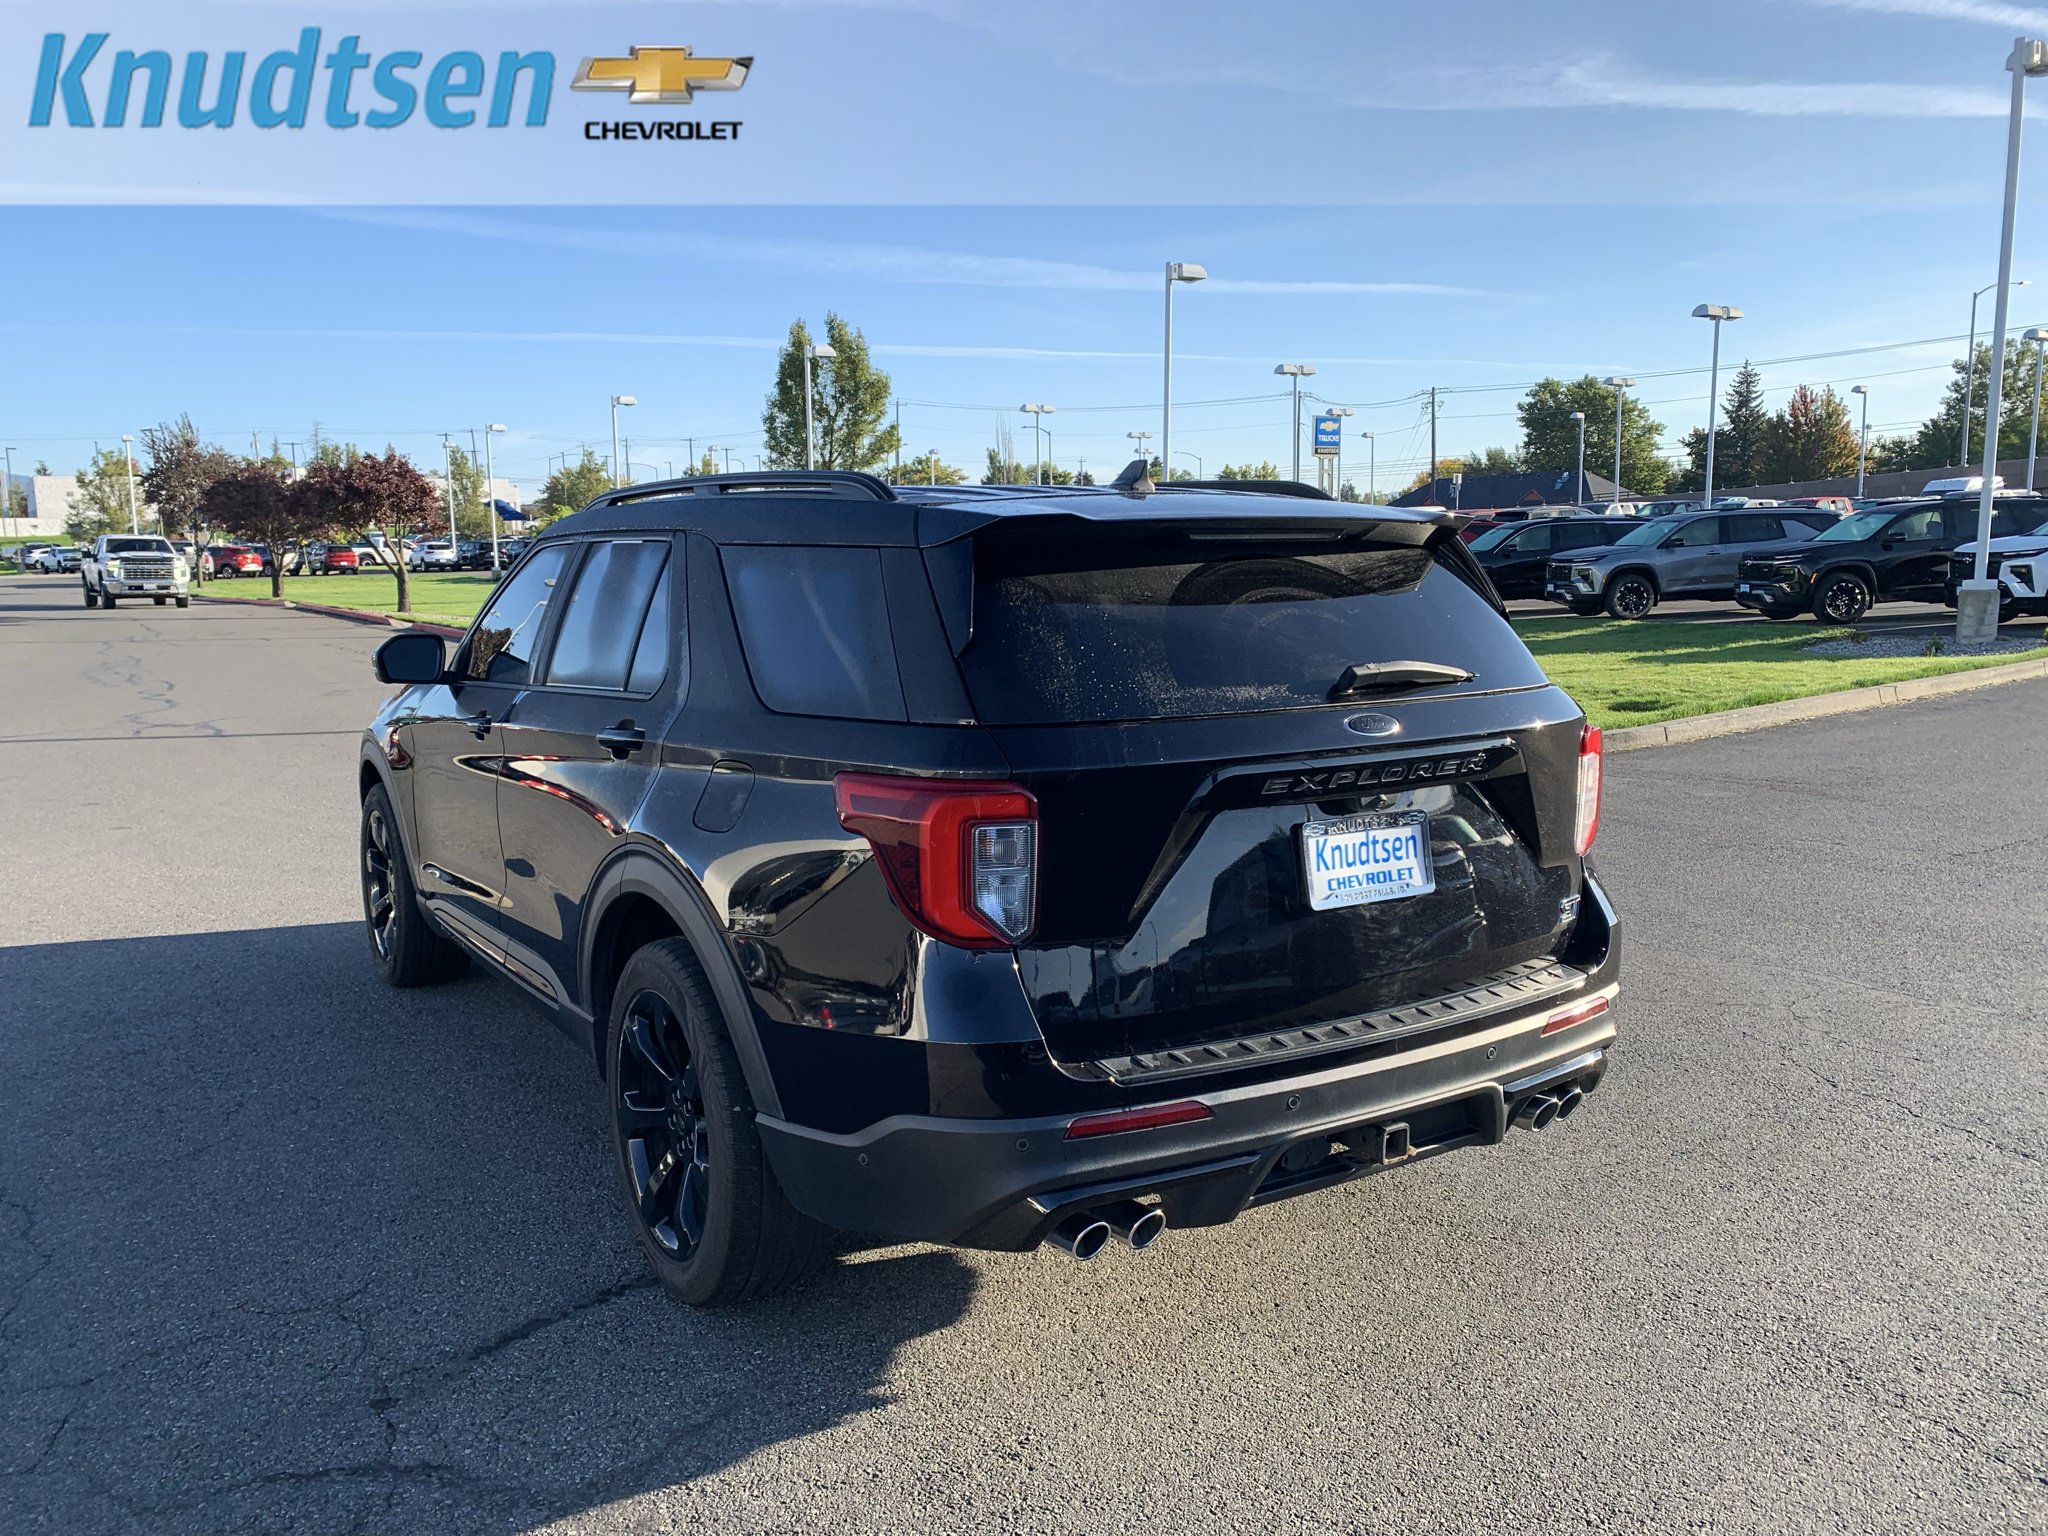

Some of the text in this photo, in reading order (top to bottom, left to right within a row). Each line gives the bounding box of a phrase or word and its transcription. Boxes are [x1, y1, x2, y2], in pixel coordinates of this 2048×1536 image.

[1261, 752, 1487, 795] EXPLORER
[1315, 831, 1418, 873] Knudtsen
[1327, 866, 1415, 892] CHEVROLET
